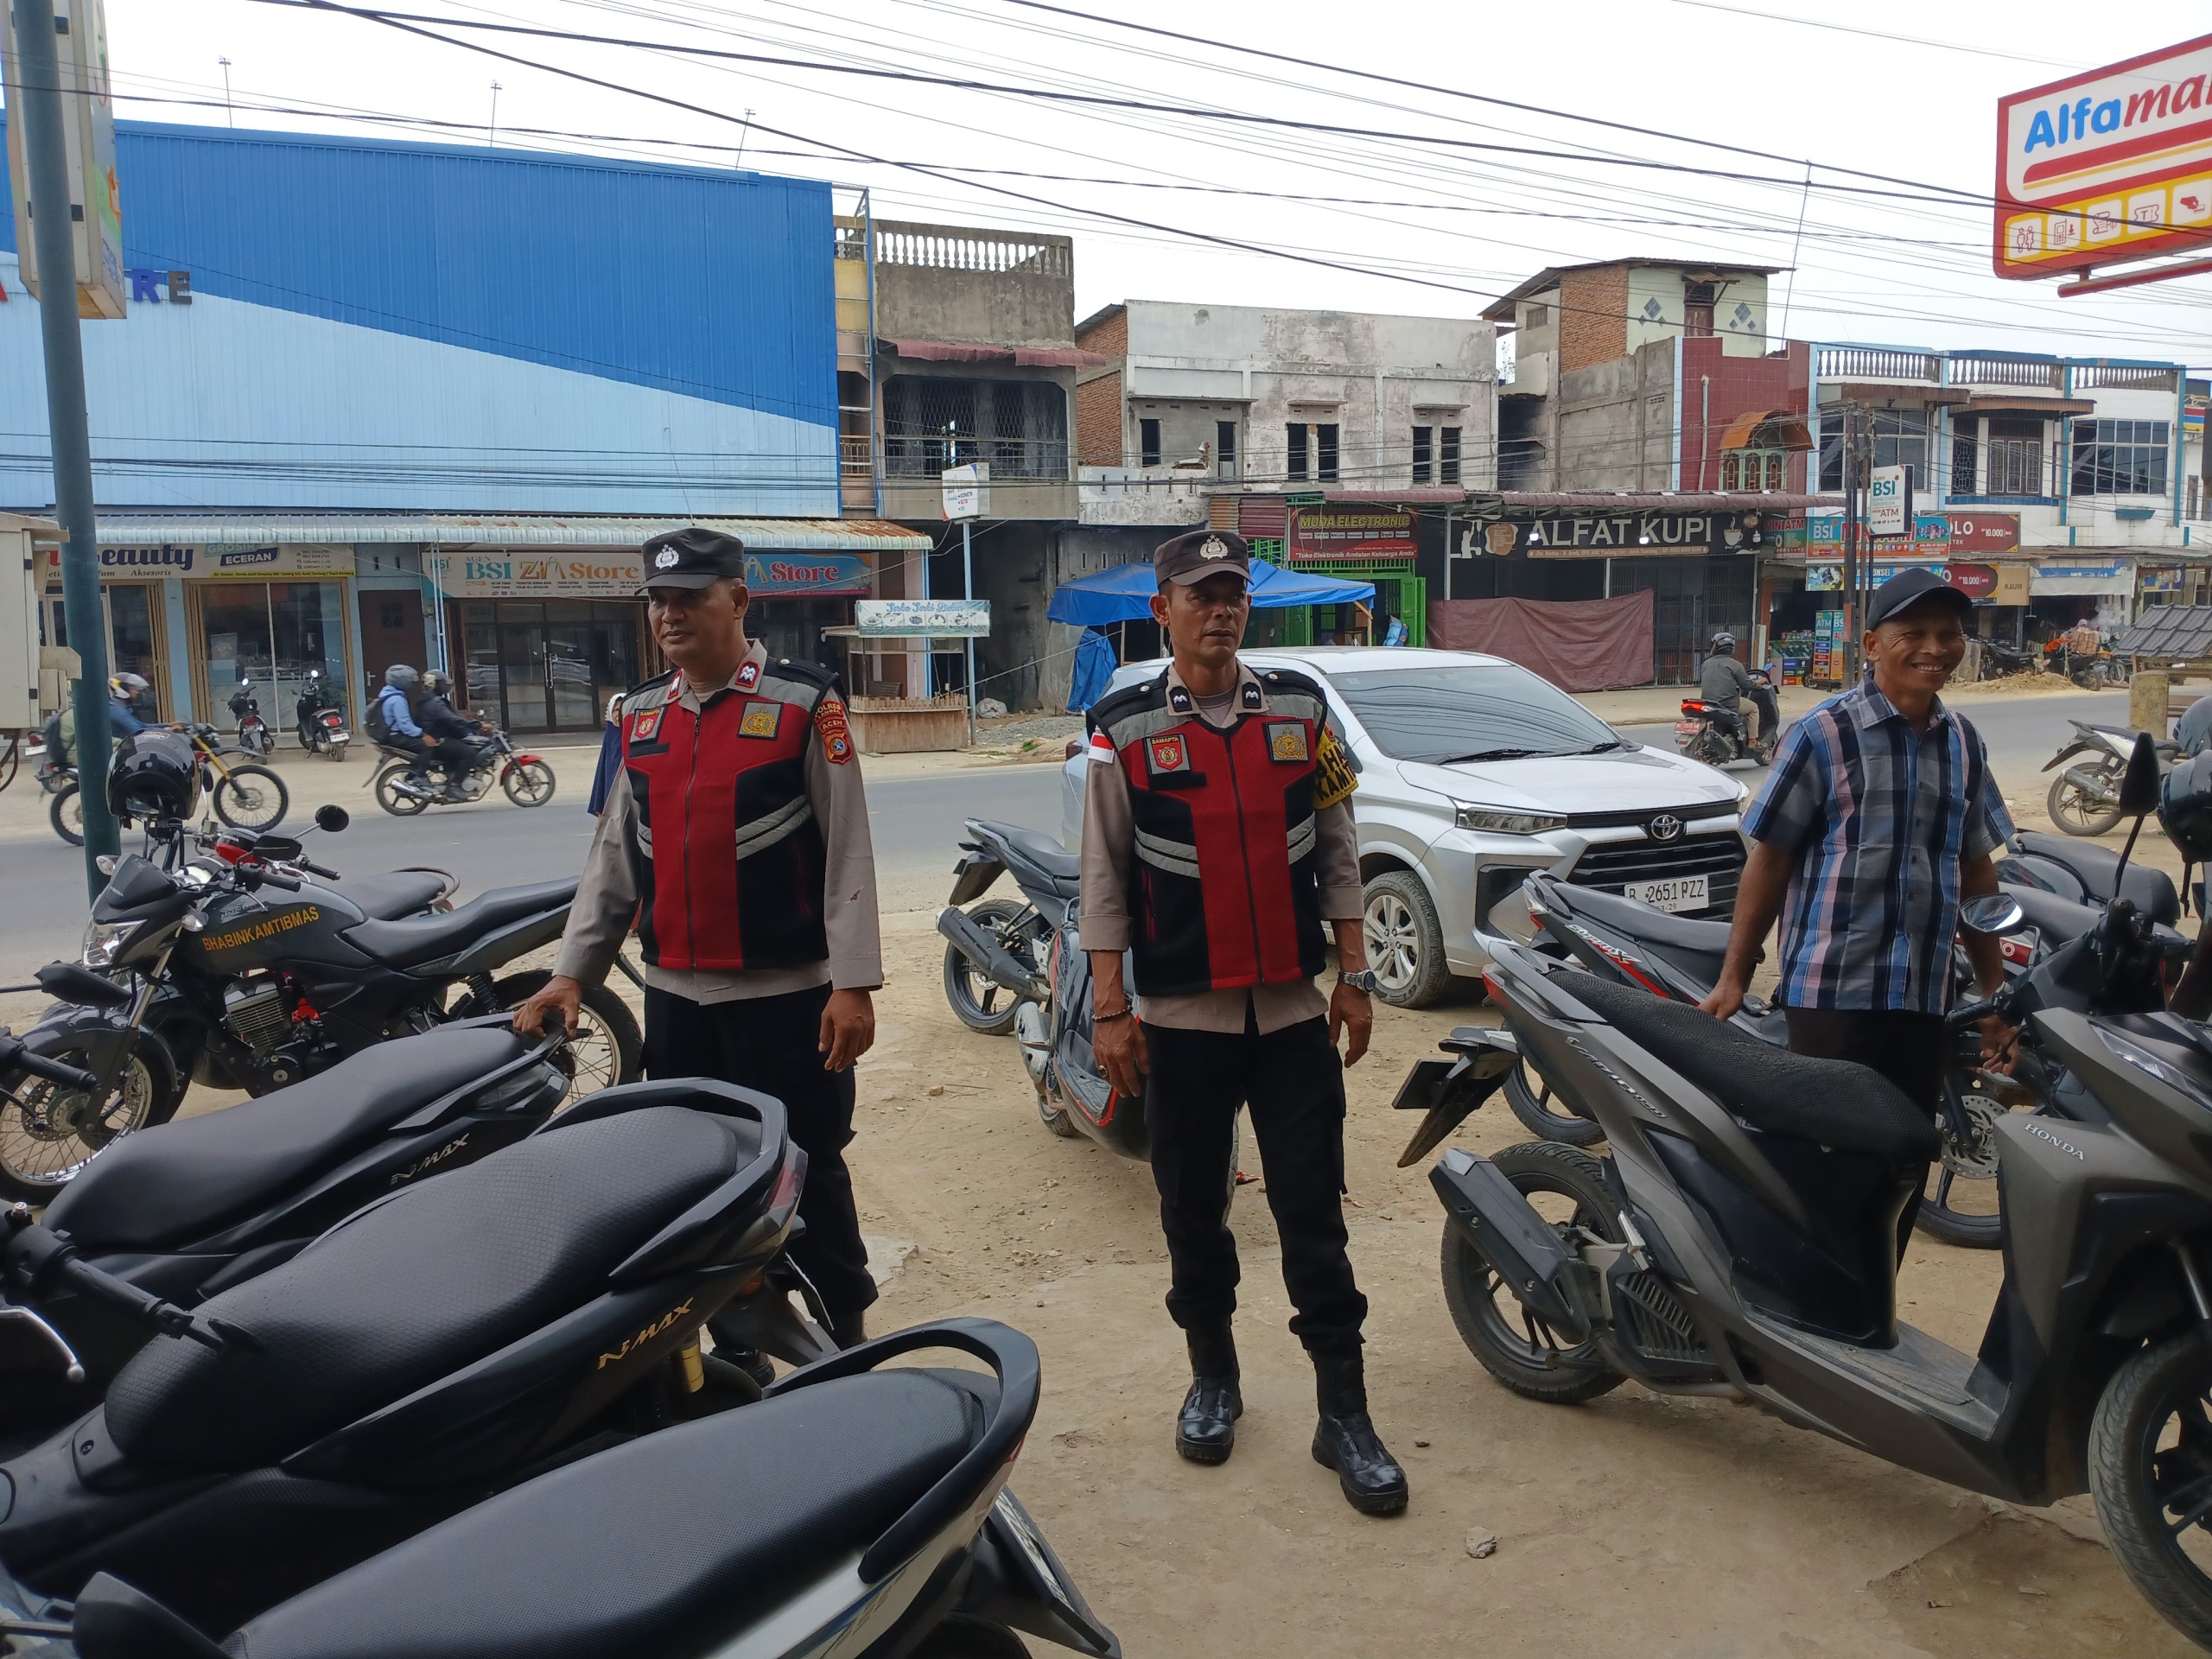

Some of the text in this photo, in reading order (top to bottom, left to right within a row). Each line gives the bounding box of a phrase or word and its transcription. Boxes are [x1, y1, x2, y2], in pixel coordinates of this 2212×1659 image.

[1873, 480, 1896, 496] BSI
[1880, 508, 1899, 517] ATM
[1299, 514, 1410, 529] MUDA ELECTRONIC
[1765, 519, 1804, 531] MINI ATM
[1949, 521, 1974, 535] LO
[1525, 518, 1631, 545] ALFAT
[1639, 517, 1712, 543] KUPI
[1814, 524, 1834, 539] BSI
[98, 544, 194, 571] eauty
[226, 553, 273, 565] ECERAN
[465, 563, 512, 579] BSI
[569, 563, 639, 580] Store
[770, 562, 840, 583] Store
[1833, 619, 1844, 627] BS
[822, 720, 842, 730] ACEH
[1647, 882, 1677, 903] 2651
[1681, 879, 1704, 899] PZZ
[2023, 1122, 2085, 1161] HONDA
